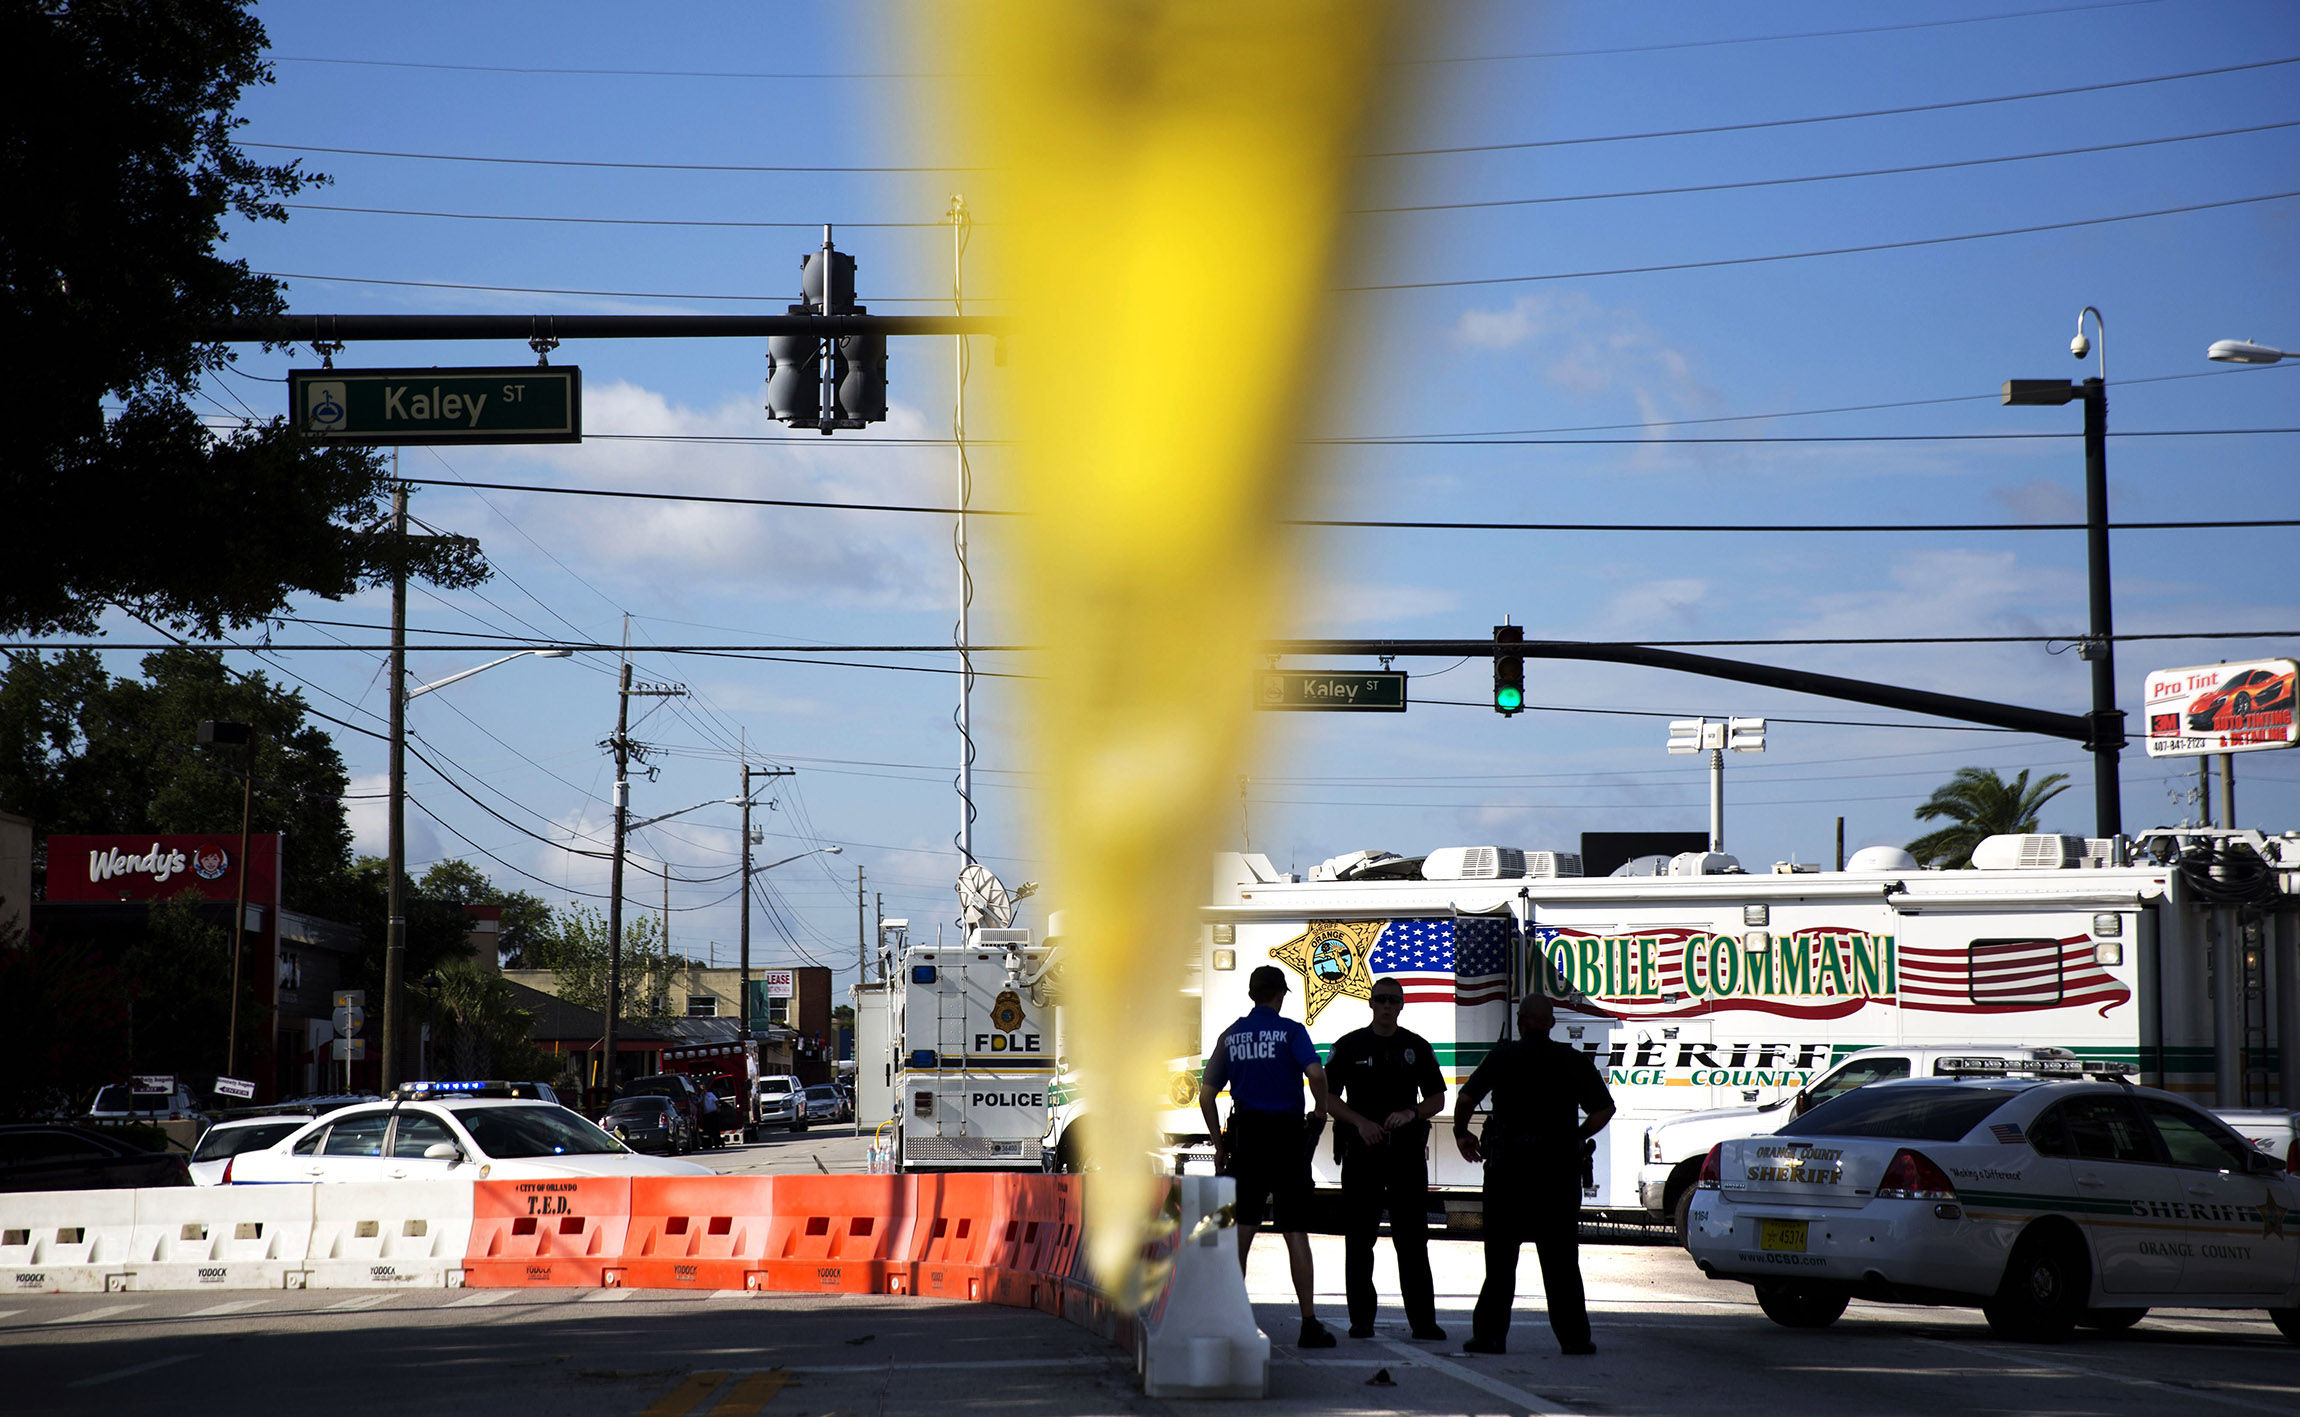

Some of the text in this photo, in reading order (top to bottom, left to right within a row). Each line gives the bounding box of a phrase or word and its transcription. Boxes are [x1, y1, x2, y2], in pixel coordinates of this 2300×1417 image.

[385, 385, 526, 428] Kaley ST
[1303, 679, 1380, 704] Kaley ST
[2154, 673, 2219, 698] Pro Tint
[2154, 713, 2177, 732] 3M
[2213, 709, 2292, 731] AUTO TINTING
[2230, 726, 2287, 747] DETAILING
[89, 842, 186, 883] Wendy's
[1311, 931, 1345, 949] ORANGE
[1511, 937, 1660, 997] MOBILE
[766, 974, 790, 985] LEASE
[1321, 977, 1353, 992] COUNTY
[975, 1034, 1040, 1052] FDLE
[1259, 1030, 1288, 1044] PARK
[1228, 1041, 1276, 1062] POLICE
[1571, 1043, 1831, 1069] HERIFF
[1691, 1069, 1816, 1087] COUNTY
[973, 1093, 1043, 1107] POLICE
[1756, 1146, 1844, 1161] ORANGE COUNTY
[1747, 1166, 1843, 1185] SHERIFF
[520, 1183, 577, 1192] CITY OF ORLANDO
[528, 1195, 571, 1215] T.E.D.
[2131, 1199, 2251, 1222] SHERIFF
[1694, 1210, 1709, 1222] 1164
[1779, 1230, 1804, 1245] 45374
[1738, 1252, 1827, 1267] www.OCSO.com
[2139, 1241, 2252, 1260] ORANGE COUNTY
[16, 1273, 46, 1282] YODOCK
[198, 1268, 227, 1277] YODOCK
